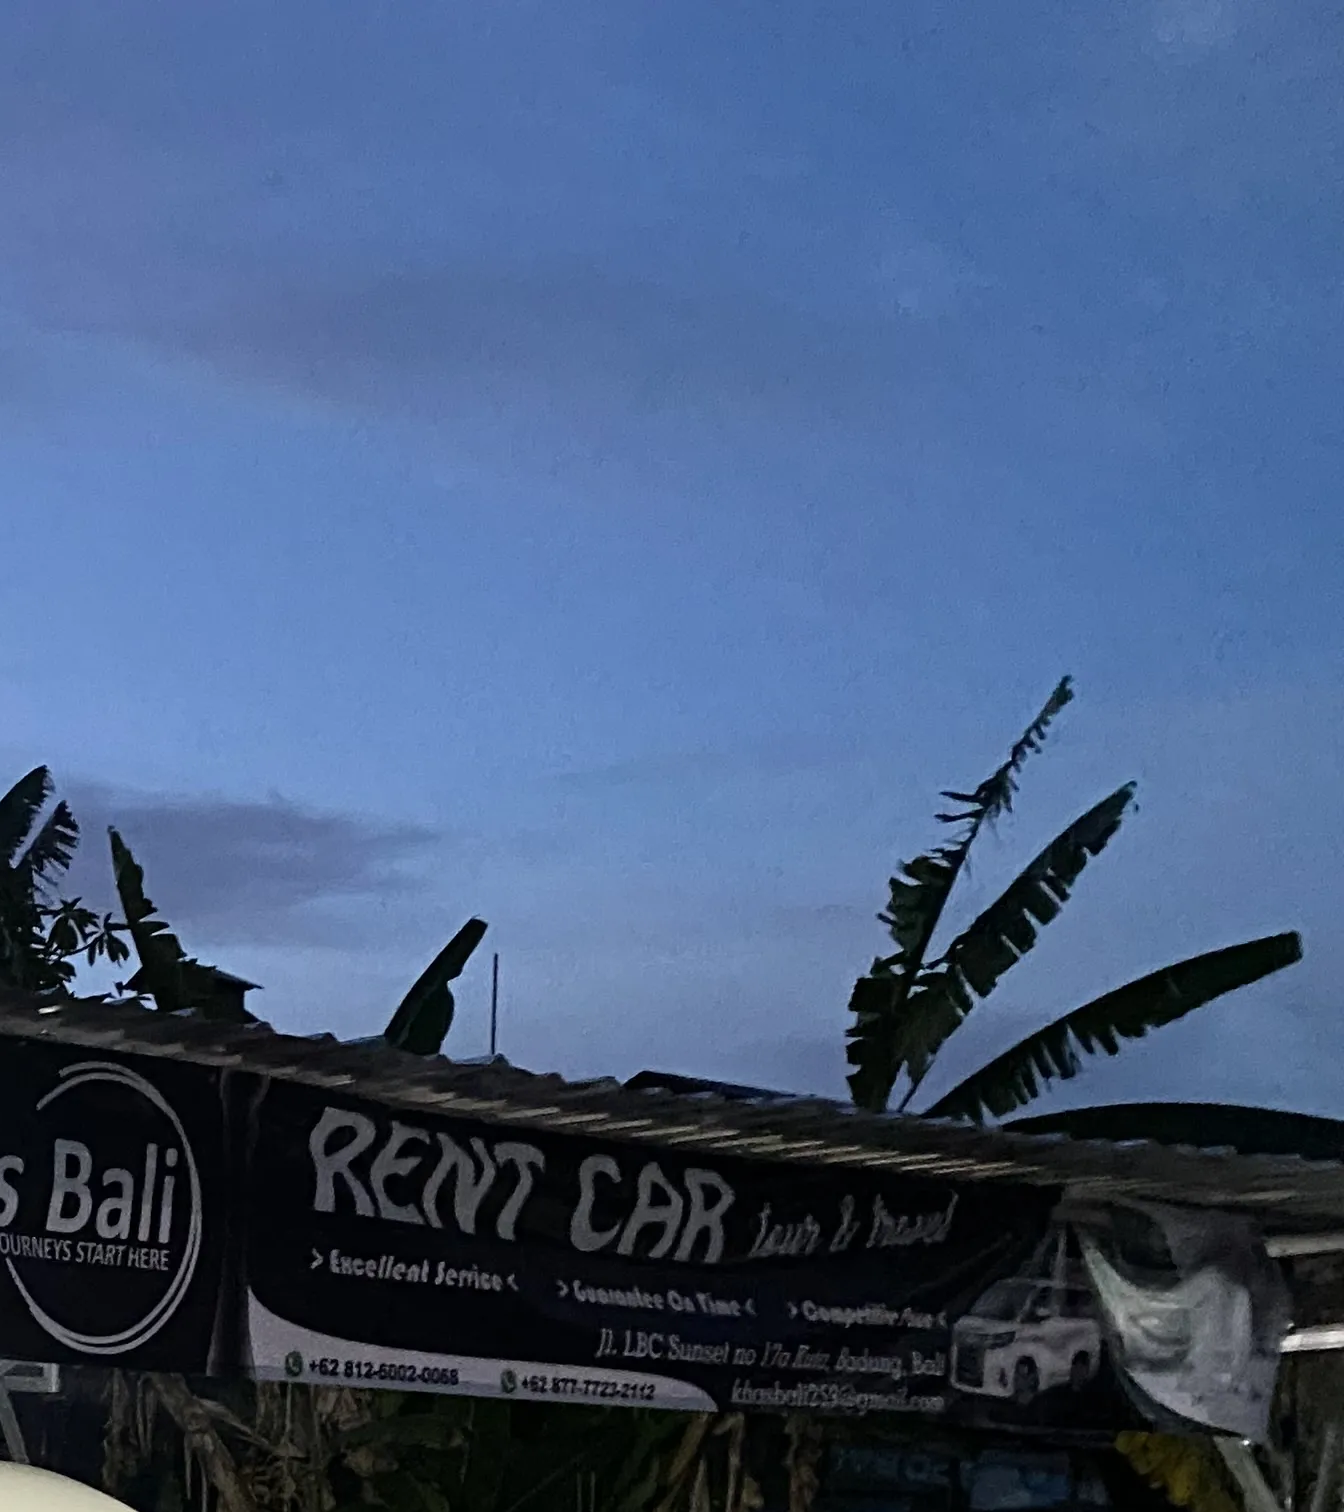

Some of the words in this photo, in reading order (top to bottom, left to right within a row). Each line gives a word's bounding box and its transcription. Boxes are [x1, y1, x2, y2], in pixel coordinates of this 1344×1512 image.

[45, 1137, 179, 1244] Bali
[309, 1106, 546, 1241] RENT
[569, 1153, 737, 1264] CAR
[75, 1241, 126, 1267] START
[127, 1246, 170, 1271] HERE
[329, 1248, 429, 1284] Excellent
[434, 1260, 503, 1292] Service
[622, 1329, 665, 1360] LBC
[309, 1357, 340, 1377] +62
